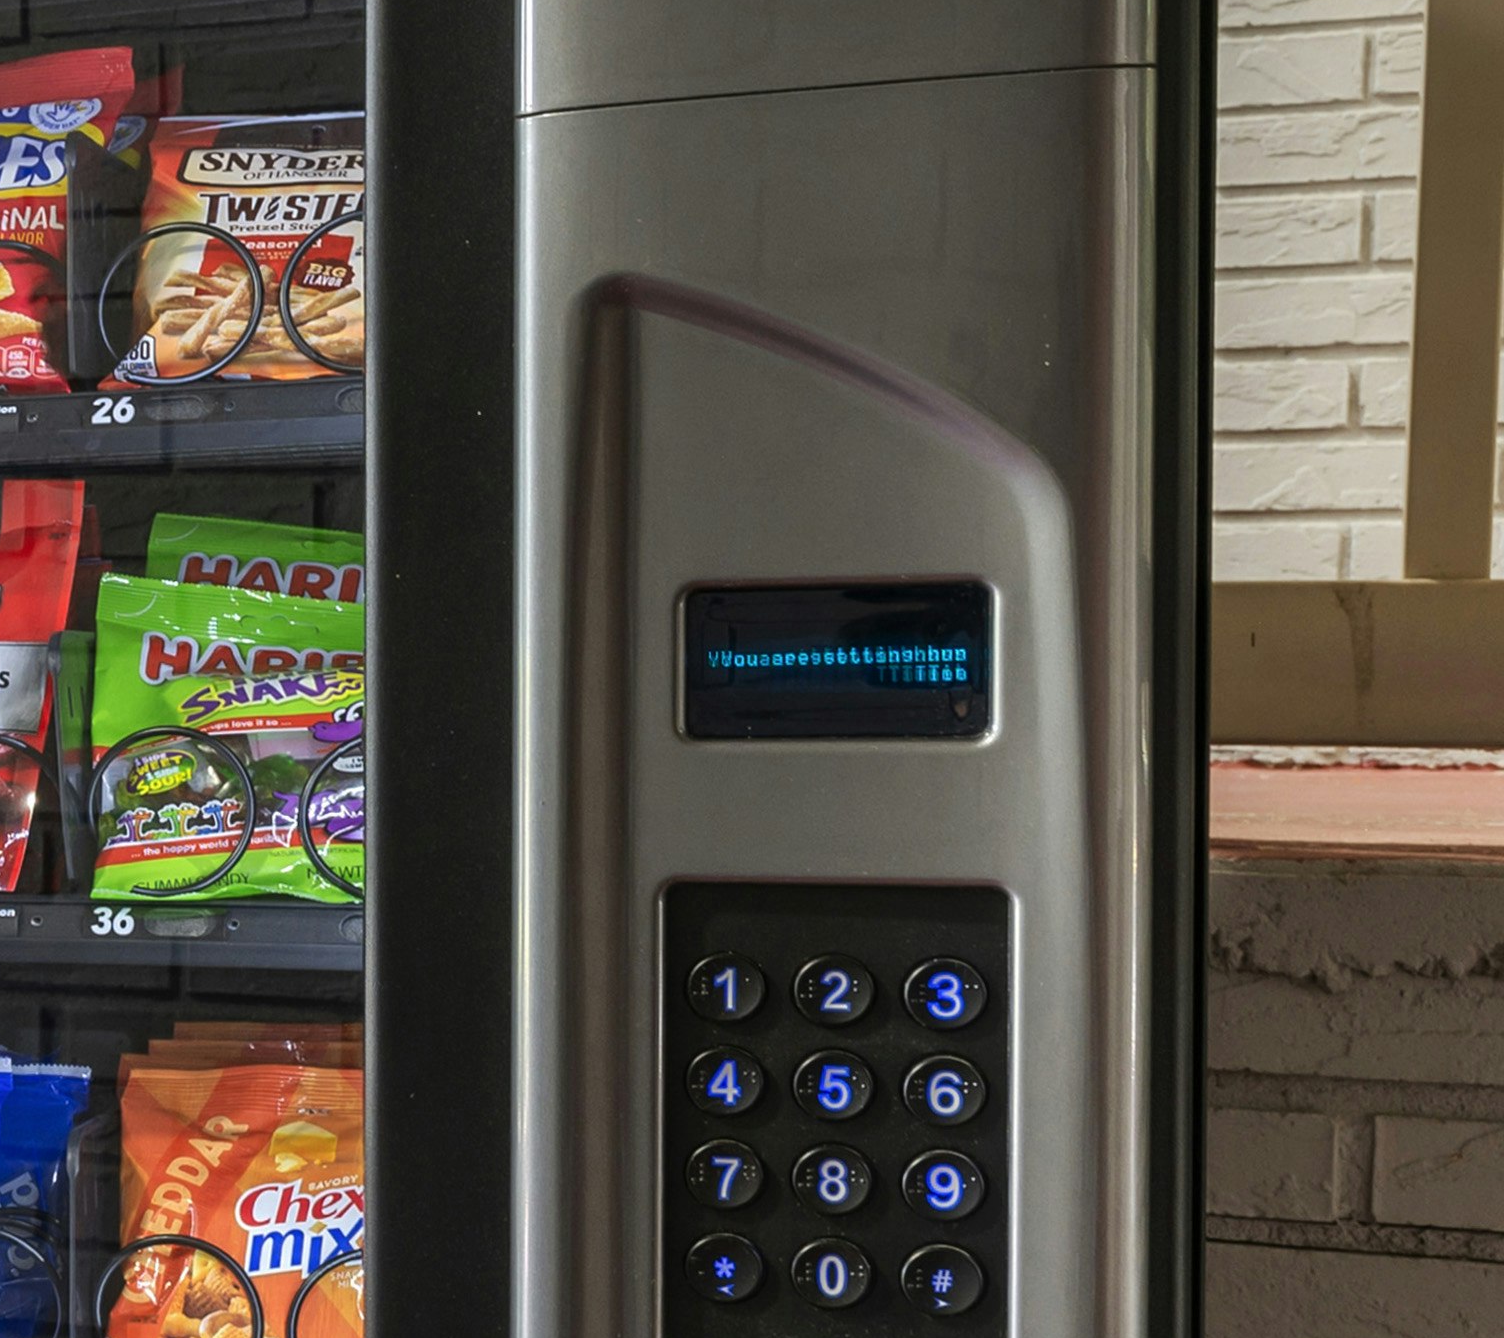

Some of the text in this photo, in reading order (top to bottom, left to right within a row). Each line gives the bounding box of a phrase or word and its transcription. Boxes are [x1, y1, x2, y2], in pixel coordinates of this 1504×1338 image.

[91, 398, 135, 425] 26
[91, 908, 135, 936] 36
[716, 968, 738, 1013] 1
[821, 970, 851, 1011] 2
[928, 972, 964, 1020] 3
[707, 1060, 741, 1106] 4
[817, 1067, 851, 1113] 5
[928, 1071, 962, 1117] 6
[308, 1174, 359, 1191] SAVORY
[712, 1155, 741, 1201] 7
[819, 1158, 848, 1204] 8
[928, 1164, 962, 1212] 9
[122, 1114, 249, 1304] CEDDAR
[239, 1184, 364, 1228] Chex
[817, 1255, 845, 1299] 0
